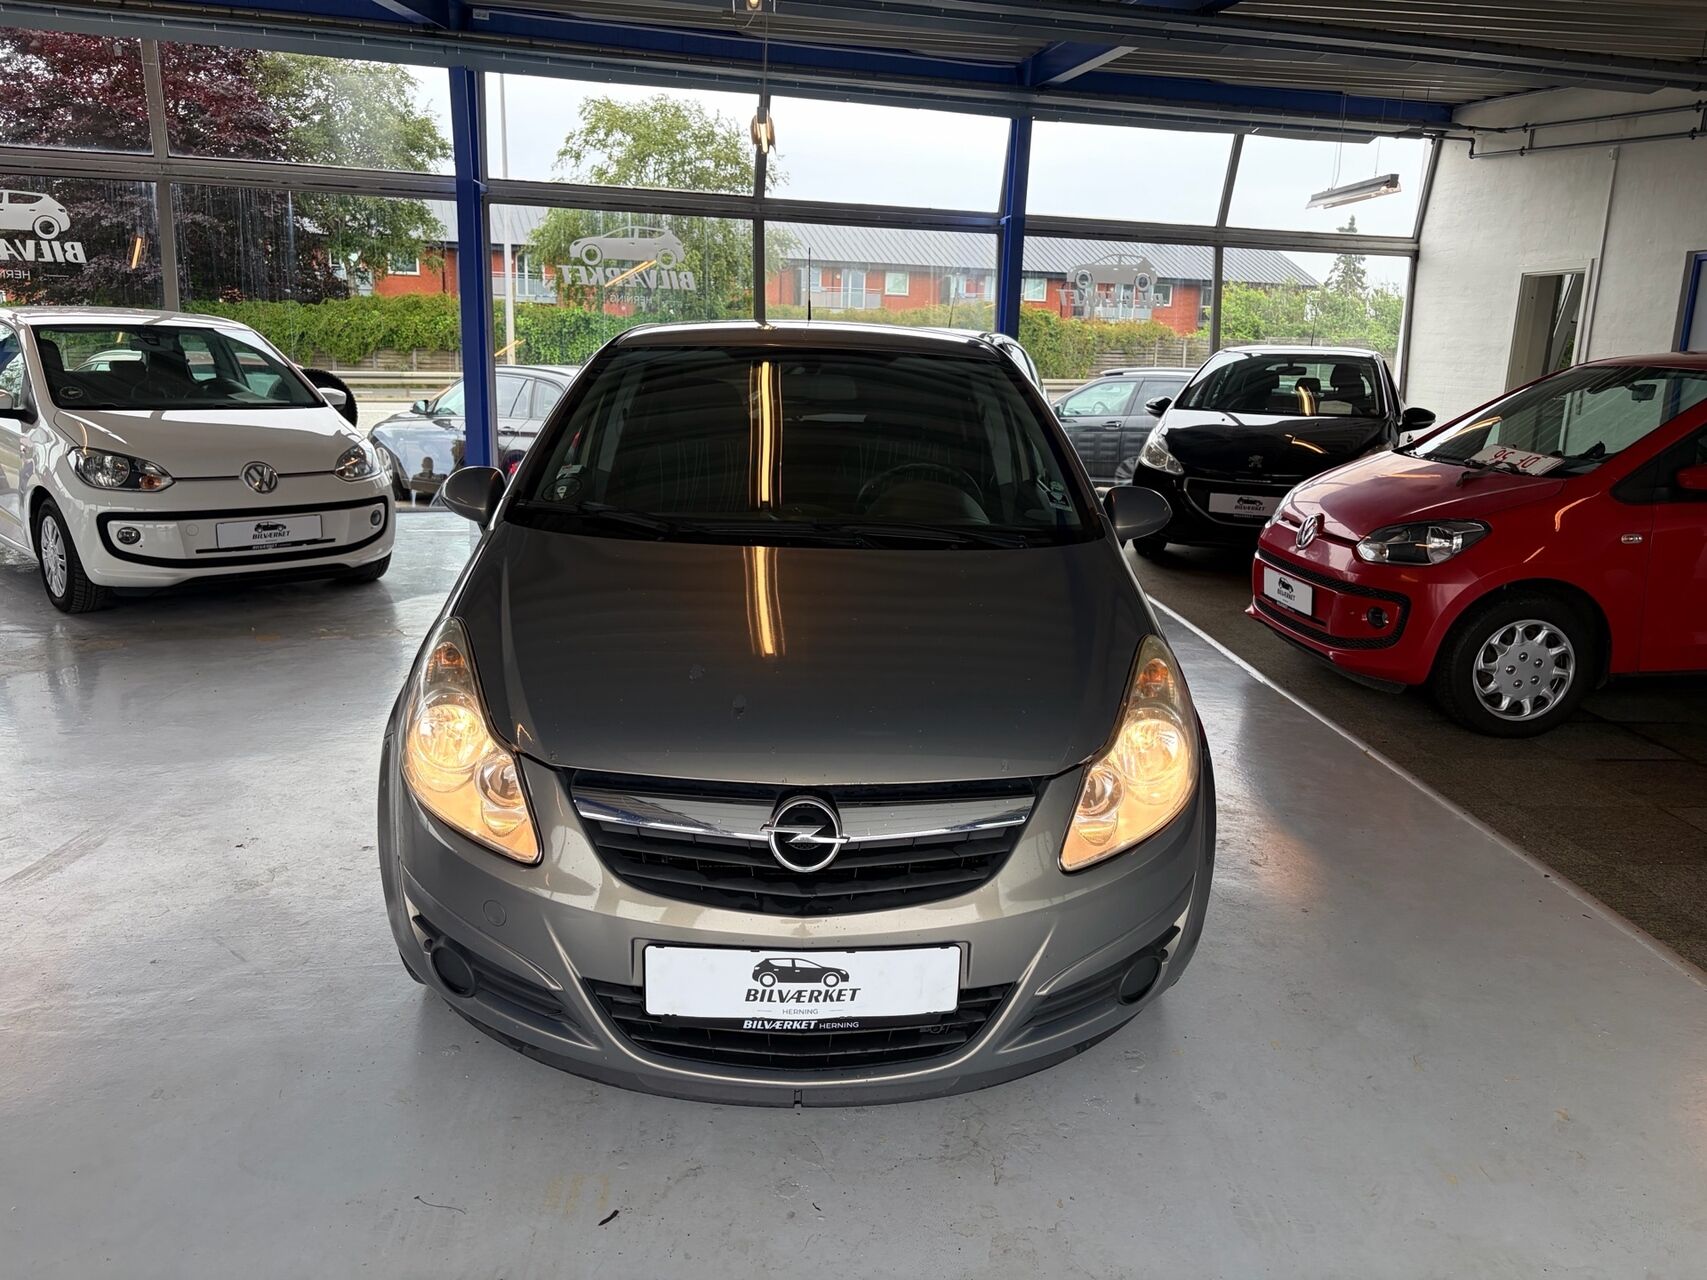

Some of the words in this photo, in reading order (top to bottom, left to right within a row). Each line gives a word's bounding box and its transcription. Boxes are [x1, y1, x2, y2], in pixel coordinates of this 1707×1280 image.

[744, 987, 861, 1003] BILVÆRKET
[743, 1020, 818, 1030] BILVÆRKET
[819, 1021, 860, 1029] HERNING
